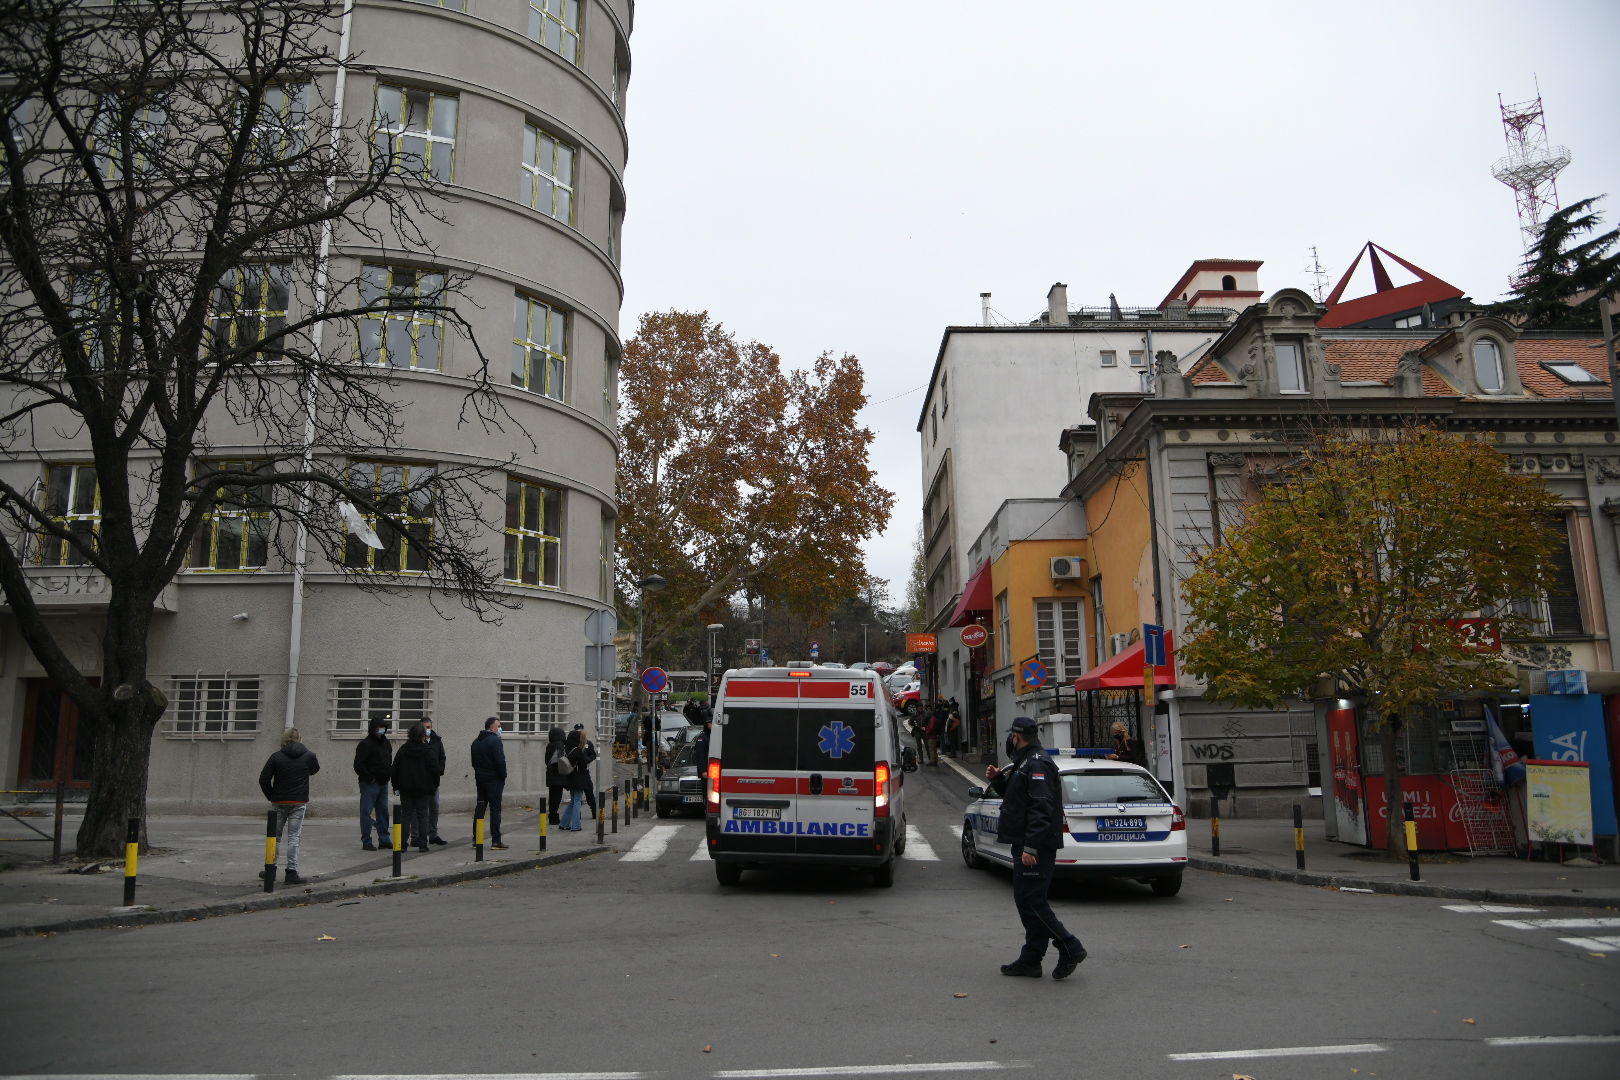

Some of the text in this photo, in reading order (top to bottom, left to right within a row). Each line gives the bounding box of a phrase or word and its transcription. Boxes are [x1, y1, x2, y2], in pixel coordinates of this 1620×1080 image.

[850, 685, 867, 696] 55
[1190, 743, 1235, 761] WDS
[738, 808, 748, 817] BG
[724, 820, 869, 836] AMBULANCE
[1098, 833, 1146, 842] ПОЛИЦИЈА
